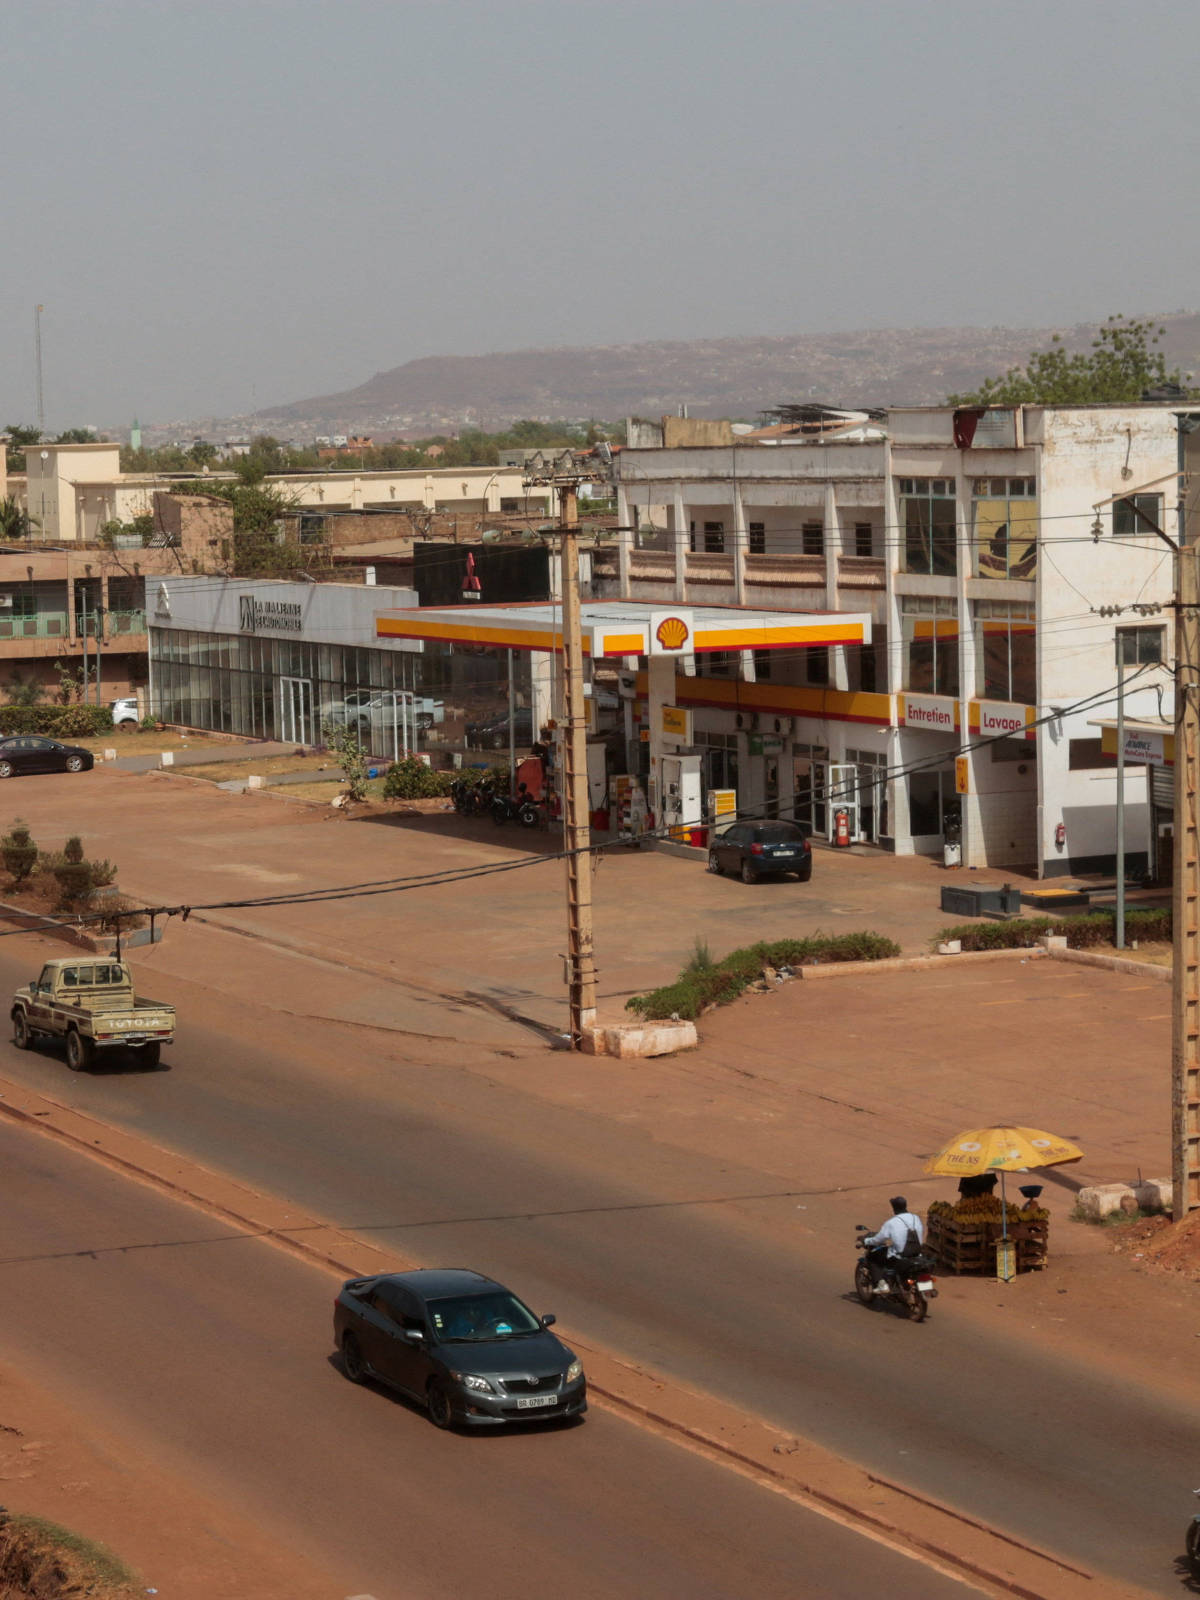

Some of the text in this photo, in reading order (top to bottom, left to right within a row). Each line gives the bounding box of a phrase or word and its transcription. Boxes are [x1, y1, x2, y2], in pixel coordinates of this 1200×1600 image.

[255, 601, 302, 616] LA MALIENNE
[908, 704, 951, 724] Entretien
[983, 712, 1022, 731] Lavage
[109, 1019, 159, 1028] TOYOTA
